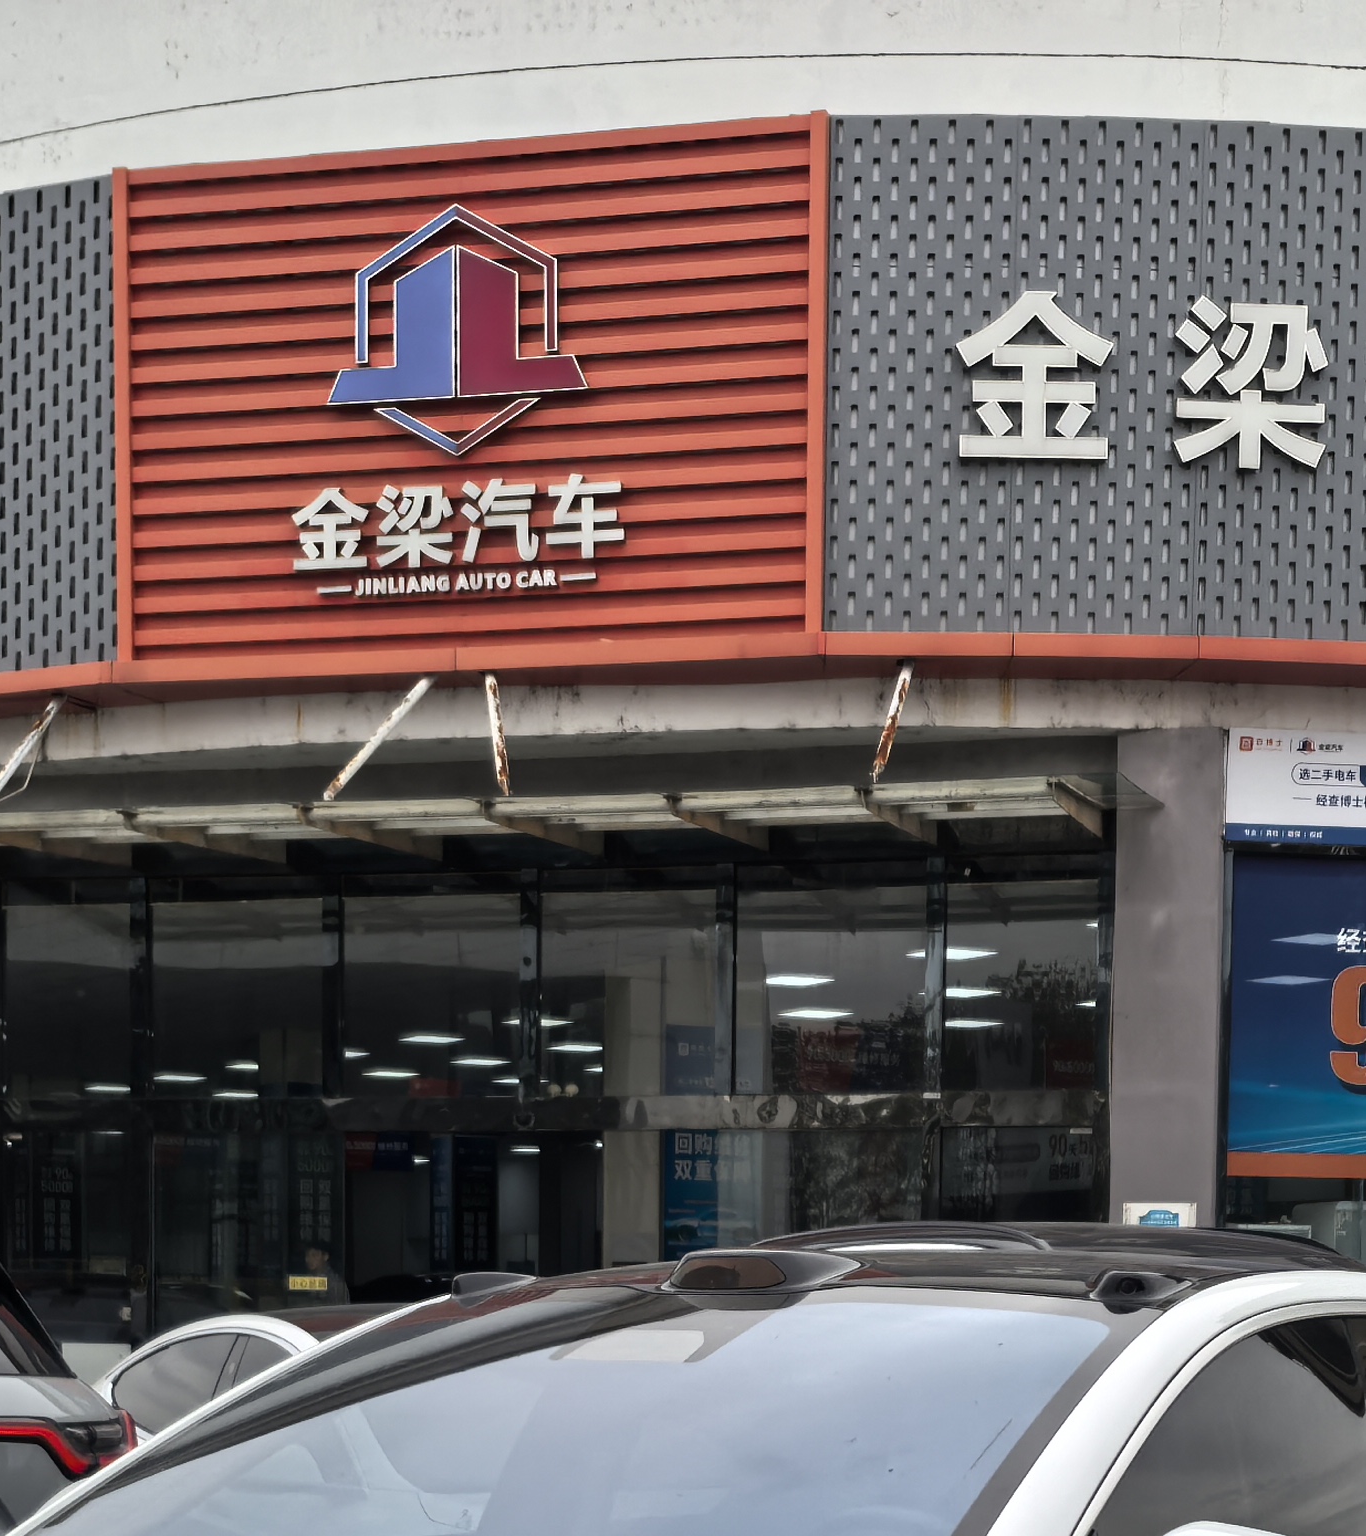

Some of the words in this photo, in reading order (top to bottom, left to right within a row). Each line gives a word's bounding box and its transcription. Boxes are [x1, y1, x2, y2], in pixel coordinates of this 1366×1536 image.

[292, 473, 625, 571] 金梁汽车
[355, 574, 451, 596] JINLIANG
[455, 572, 512, 591] AUTO
[515, 569, 557, 589] CAR
[1299, 768, 1357, 782] 选二手电车
